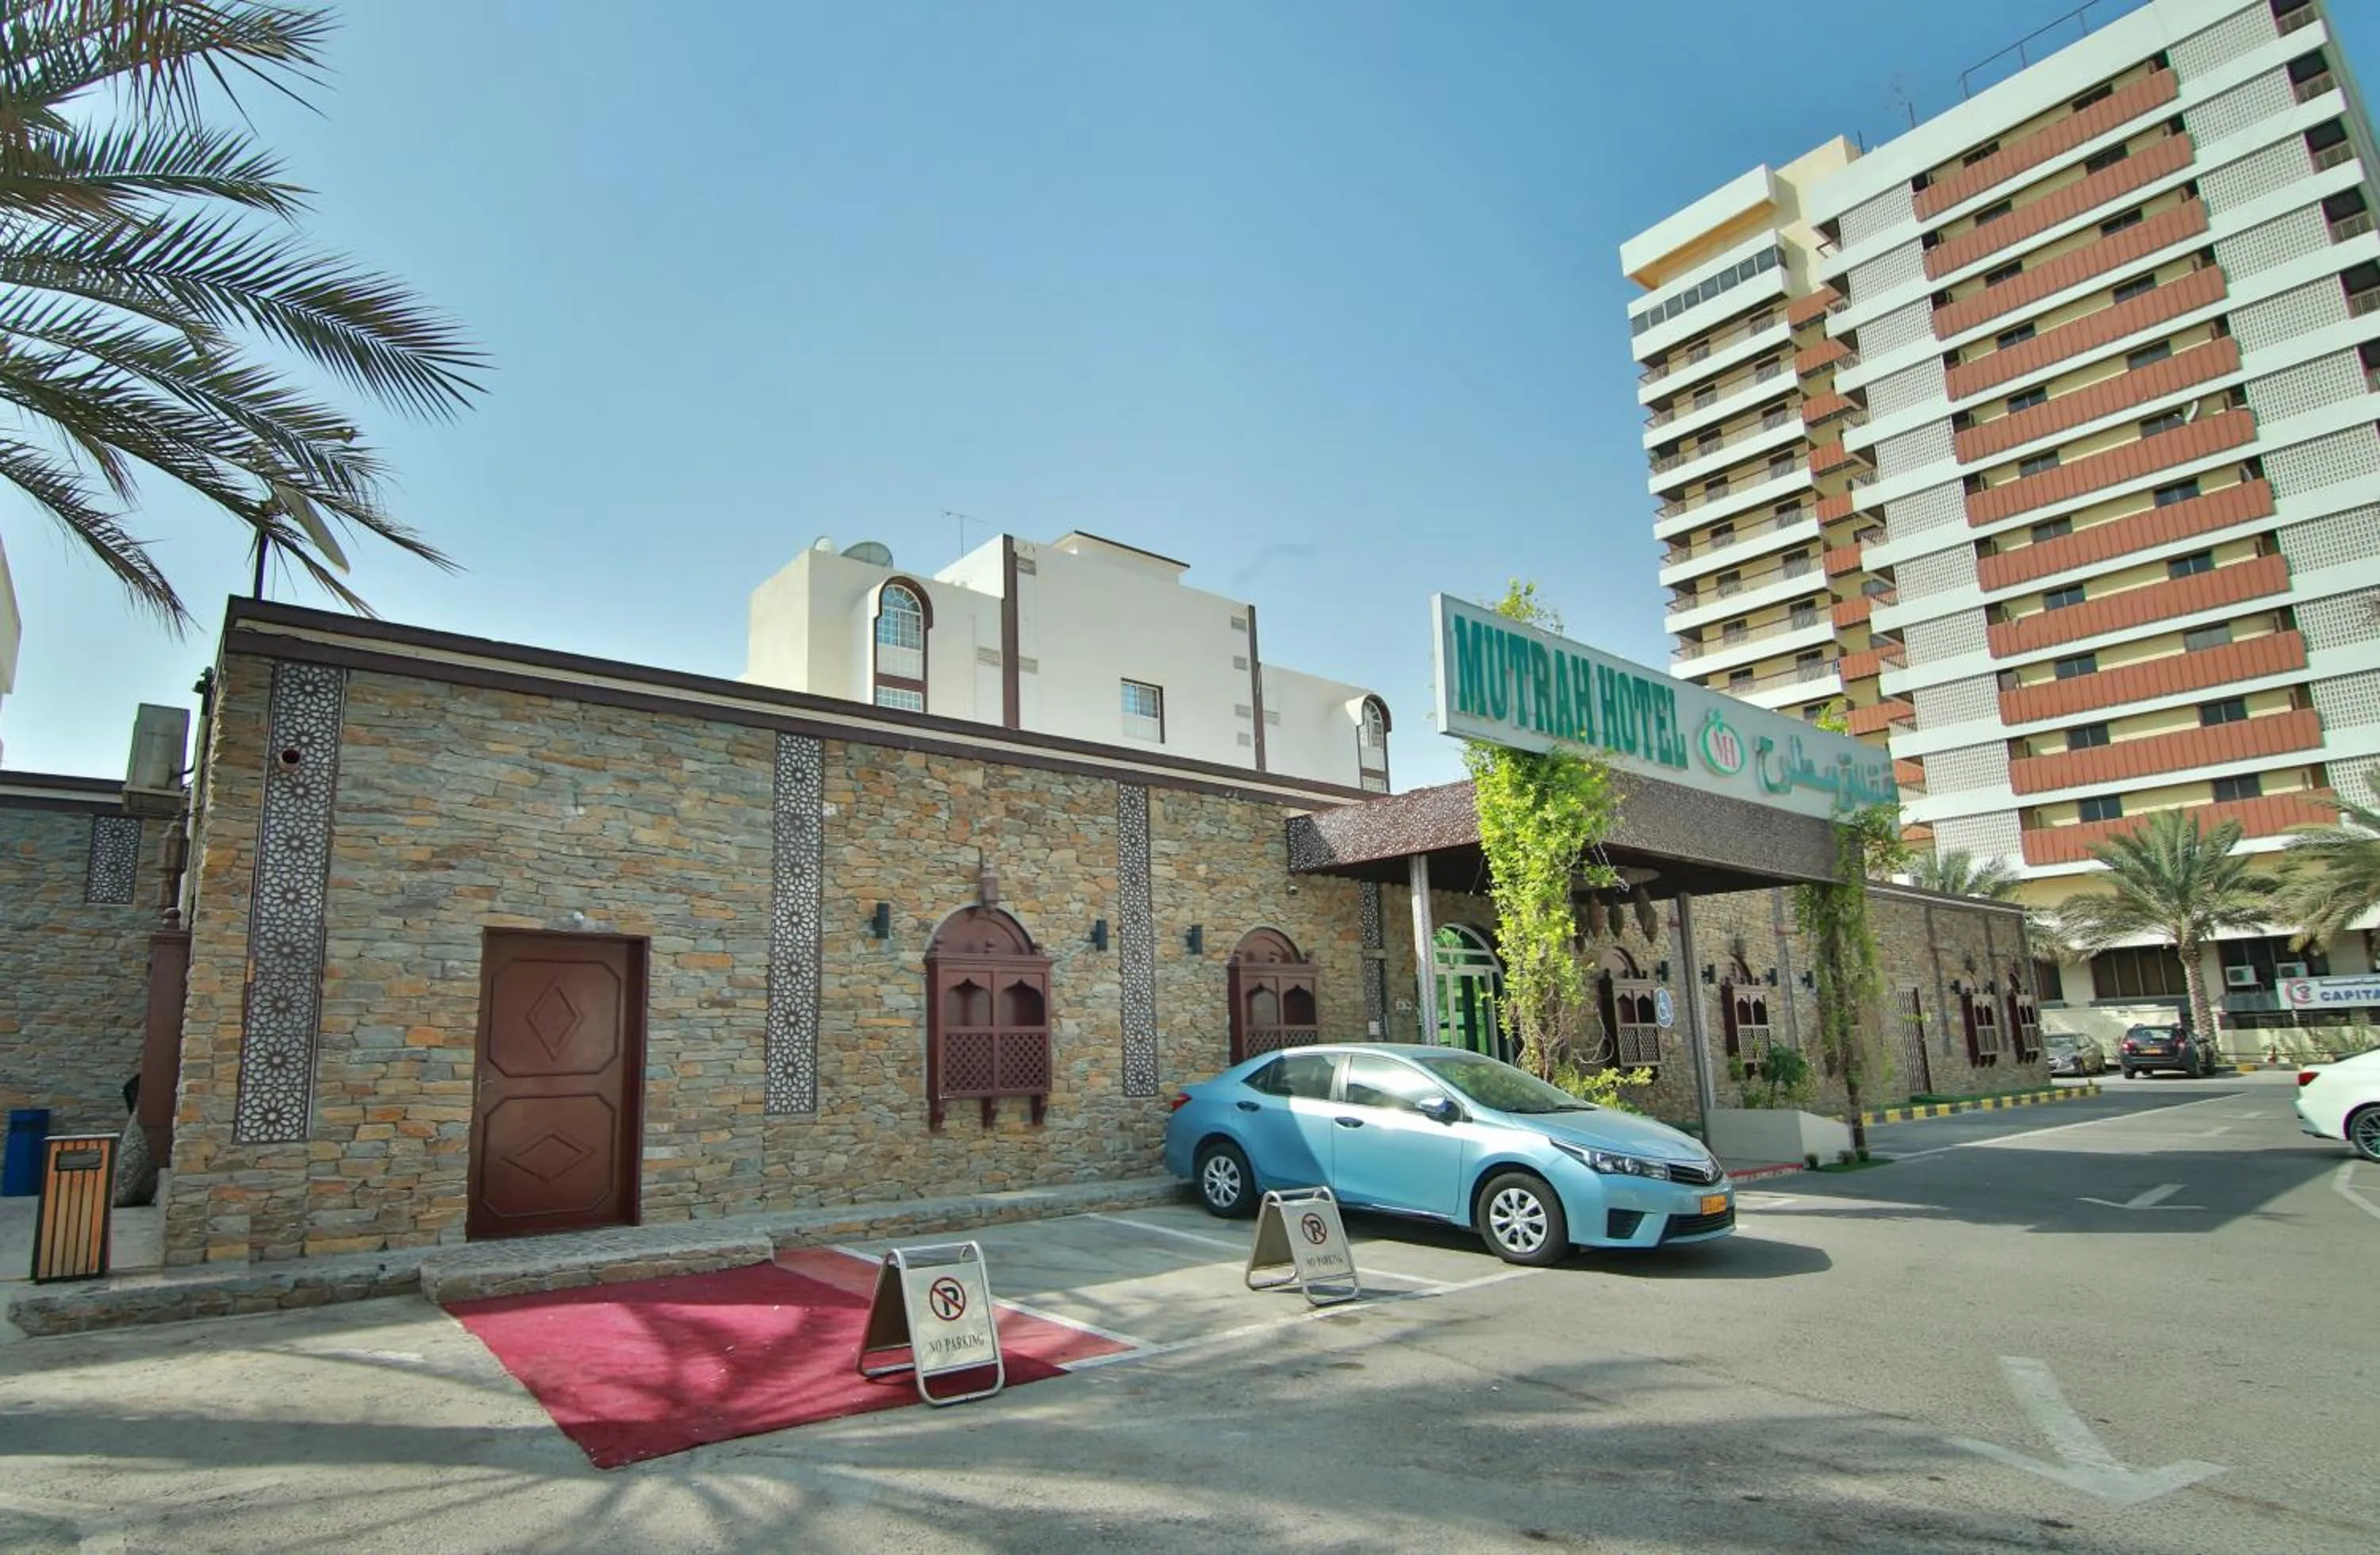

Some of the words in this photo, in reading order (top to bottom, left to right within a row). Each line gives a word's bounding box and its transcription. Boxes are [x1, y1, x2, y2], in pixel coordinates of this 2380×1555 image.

[1453, 614, 1596, 747] MUTRAH
[1596, 663, 1689, 770] HOTEL
[928, 1339, 942, 1353] NO
[944, 1333, 985, 1353] PARKING
